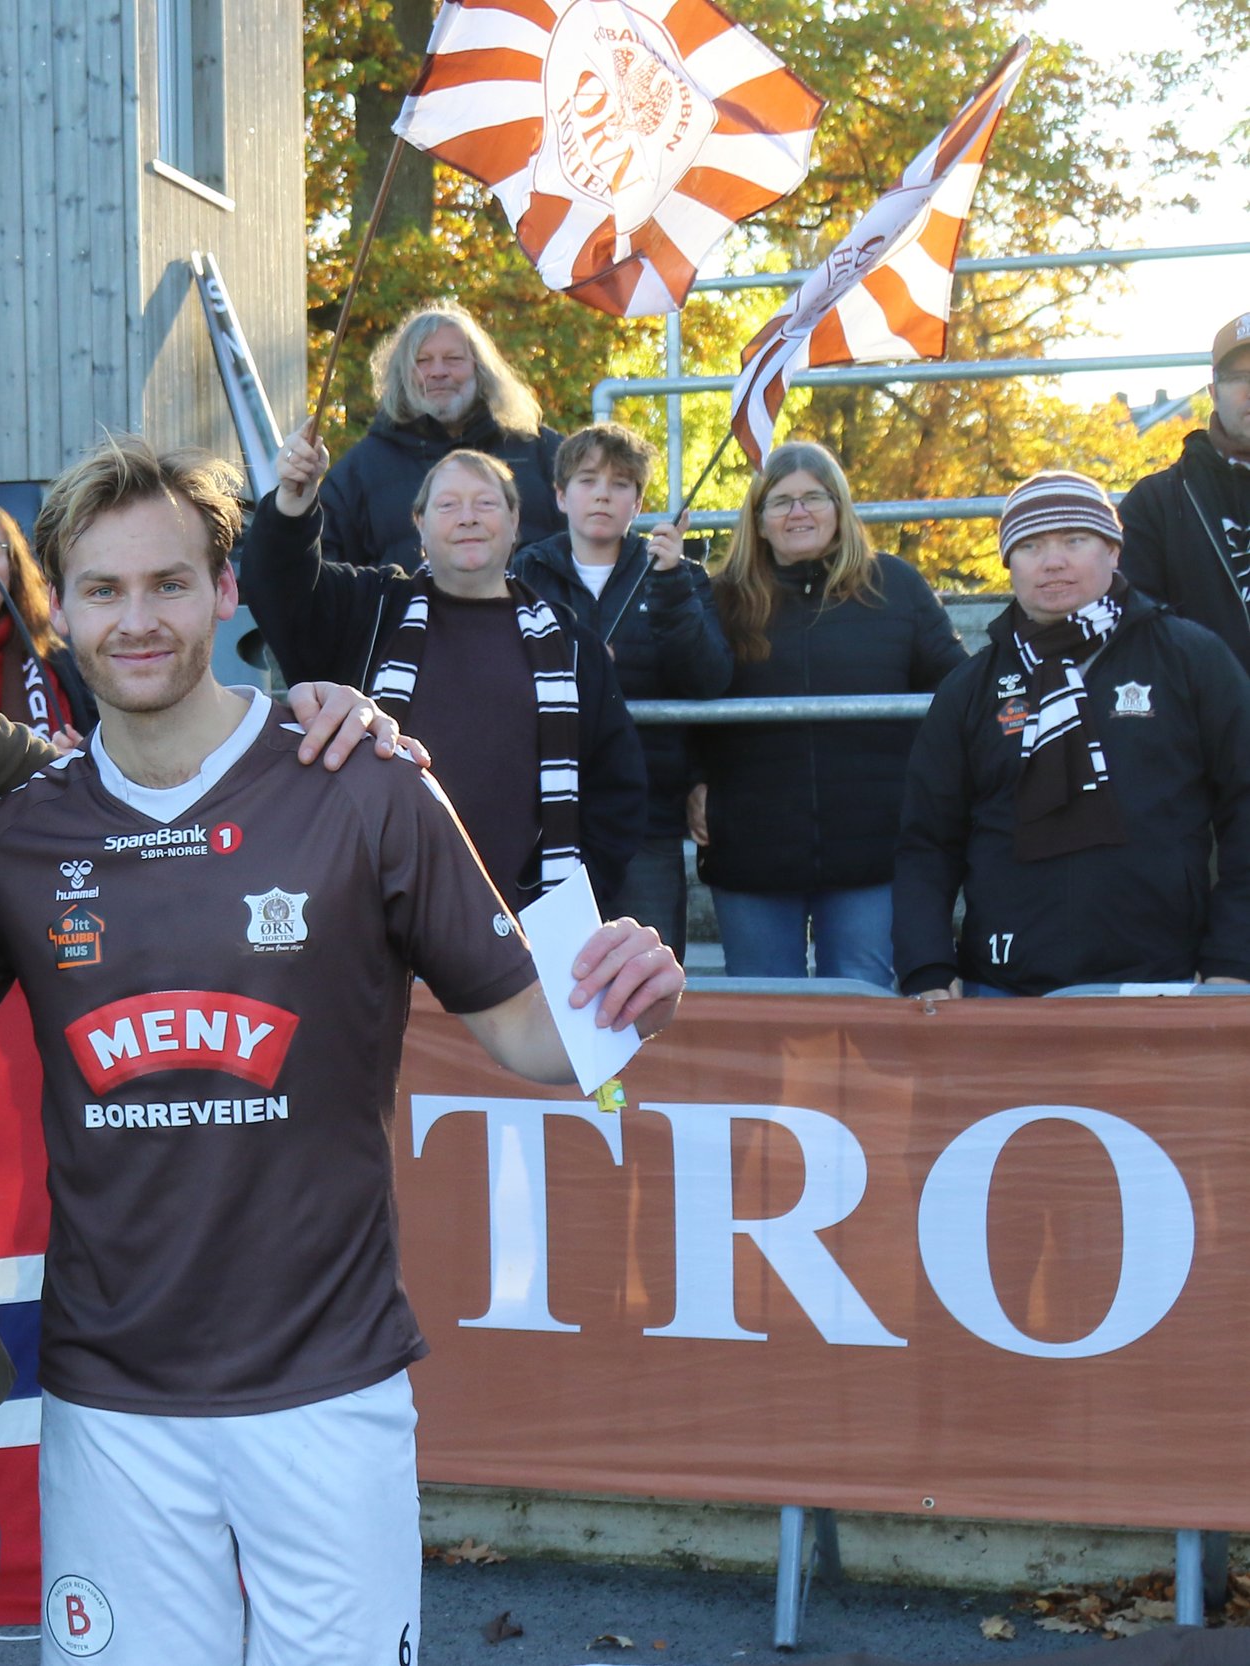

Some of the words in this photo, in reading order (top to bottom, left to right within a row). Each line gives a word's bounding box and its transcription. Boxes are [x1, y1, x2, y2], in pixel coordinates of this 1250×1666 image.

[104, 824, 207, 852] SpareBank
[219, 828, 232, 849] 1
[140, 845, 208, 860] SØR-NORGE
[56, 886, 99, 901] hummel
[62, 918, 90, 932] Ditt
[260, 922, 295, 935] ØRN
[58, 932, 95, 944] KLUBB
[261, 934, 295, 942] HORTEN
[989, 933, 1014, 964] 17
[64, 945, 88, 957] HUS
[88, 1009, 274, 1070] MENY
[85, 1095, 289, 1128] BORREVEIEN
[411, 1093, 1195, 1360] TRO
[66, 1595, 91, 1636] B
[399, 1621, 412, 1666] 6
